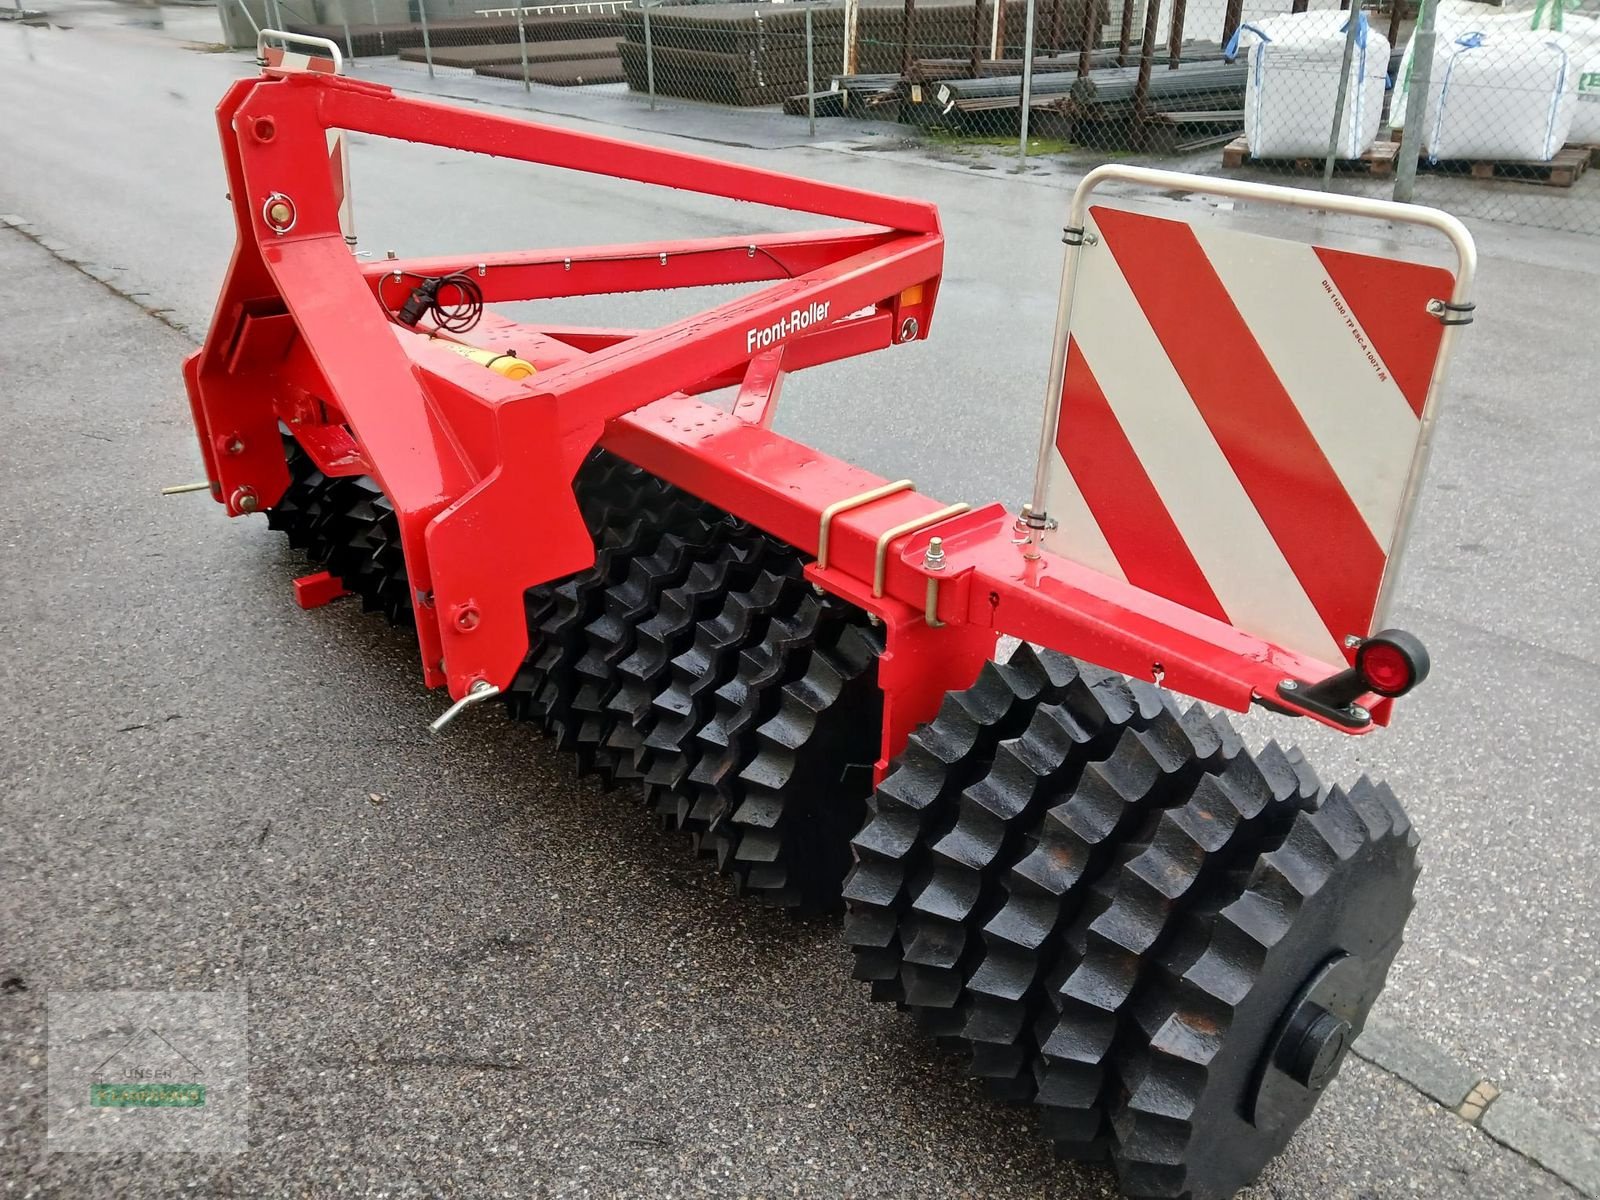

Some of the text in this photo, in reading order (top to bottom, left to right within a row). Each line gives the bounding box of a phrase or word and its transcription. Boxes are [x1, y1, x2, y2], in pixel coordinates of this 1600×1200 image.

[747, 301, 831, 353] Front-Roller
[1322, 279, 1333, 294] DIN
[1330, 294, 1346, 315] 11030
[1346, 318, 1355, 328] TP
[1366, 351, 1381, 372] 10071
